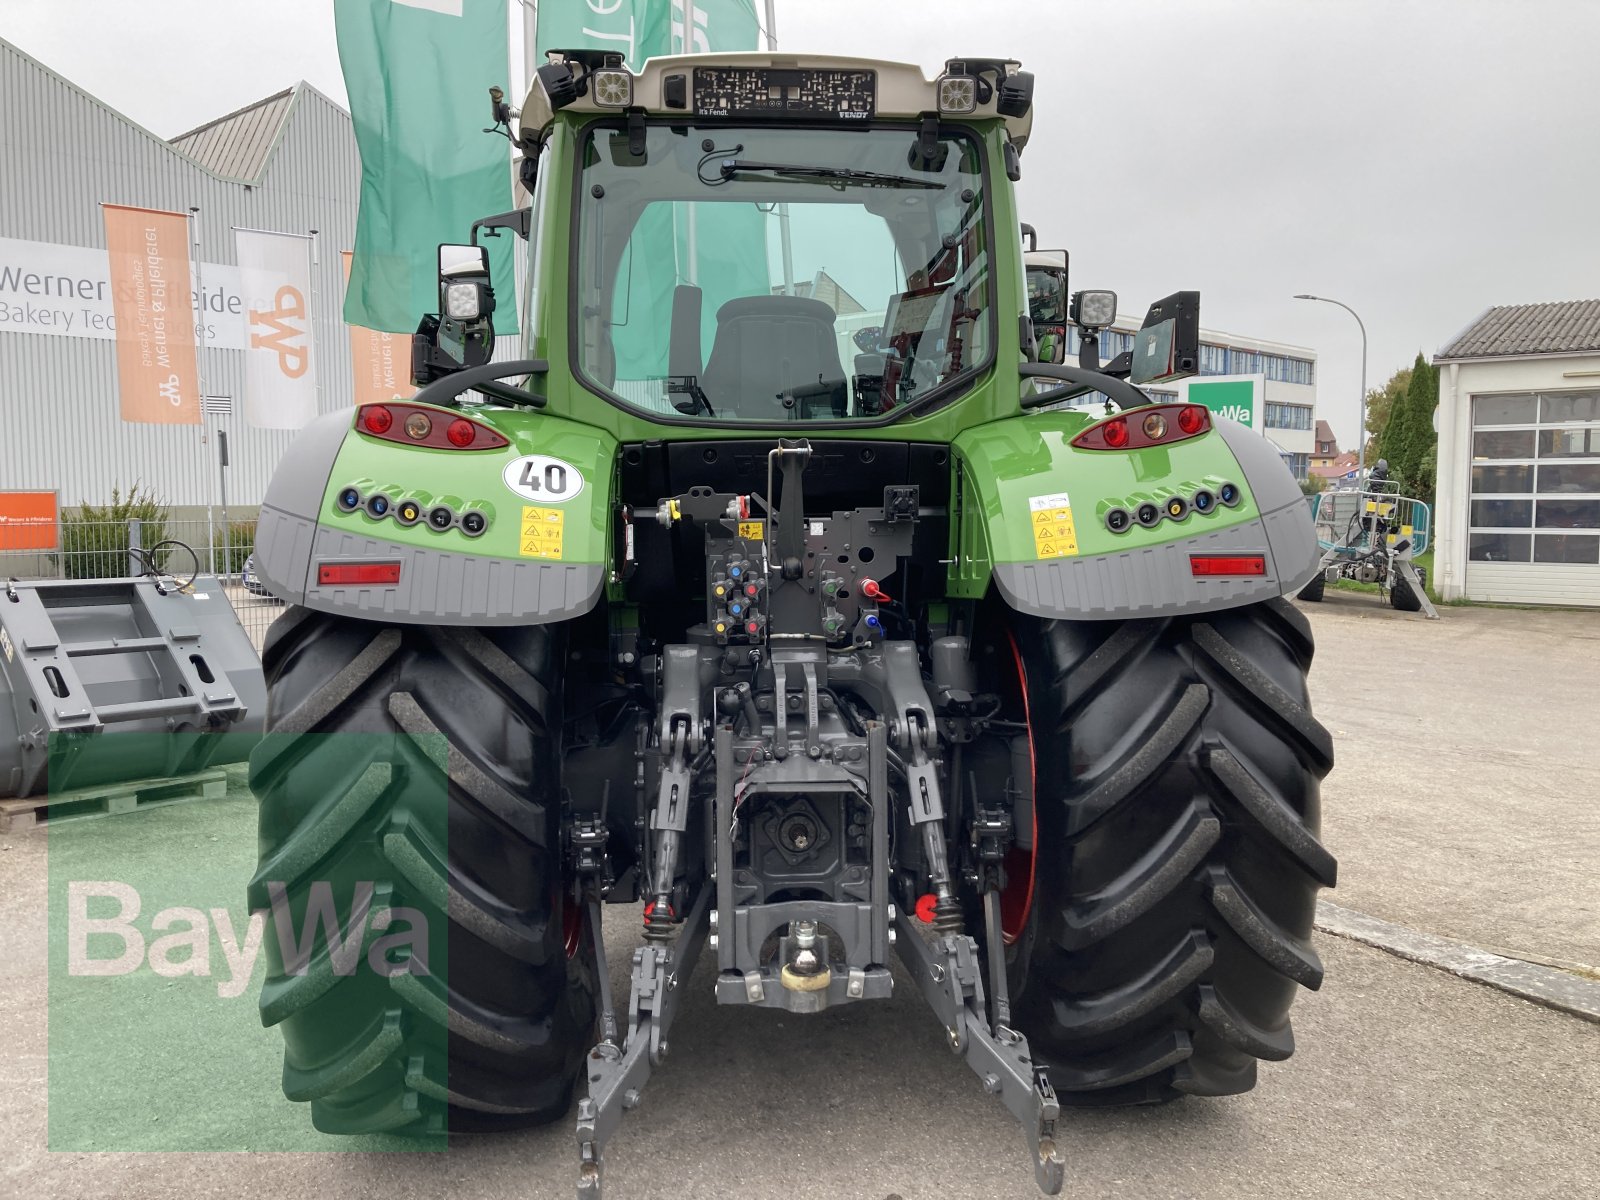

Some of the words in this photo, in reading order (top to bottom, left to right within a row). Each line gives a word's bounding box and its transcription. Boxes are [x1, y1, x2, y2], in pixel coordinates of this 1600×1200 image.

[0, 266, 107, 301] Werner
[0, 301, 74, 332] Bakery
[1210, 405, 1250, 422] Wa
[519, 461, 567, 494] 40
